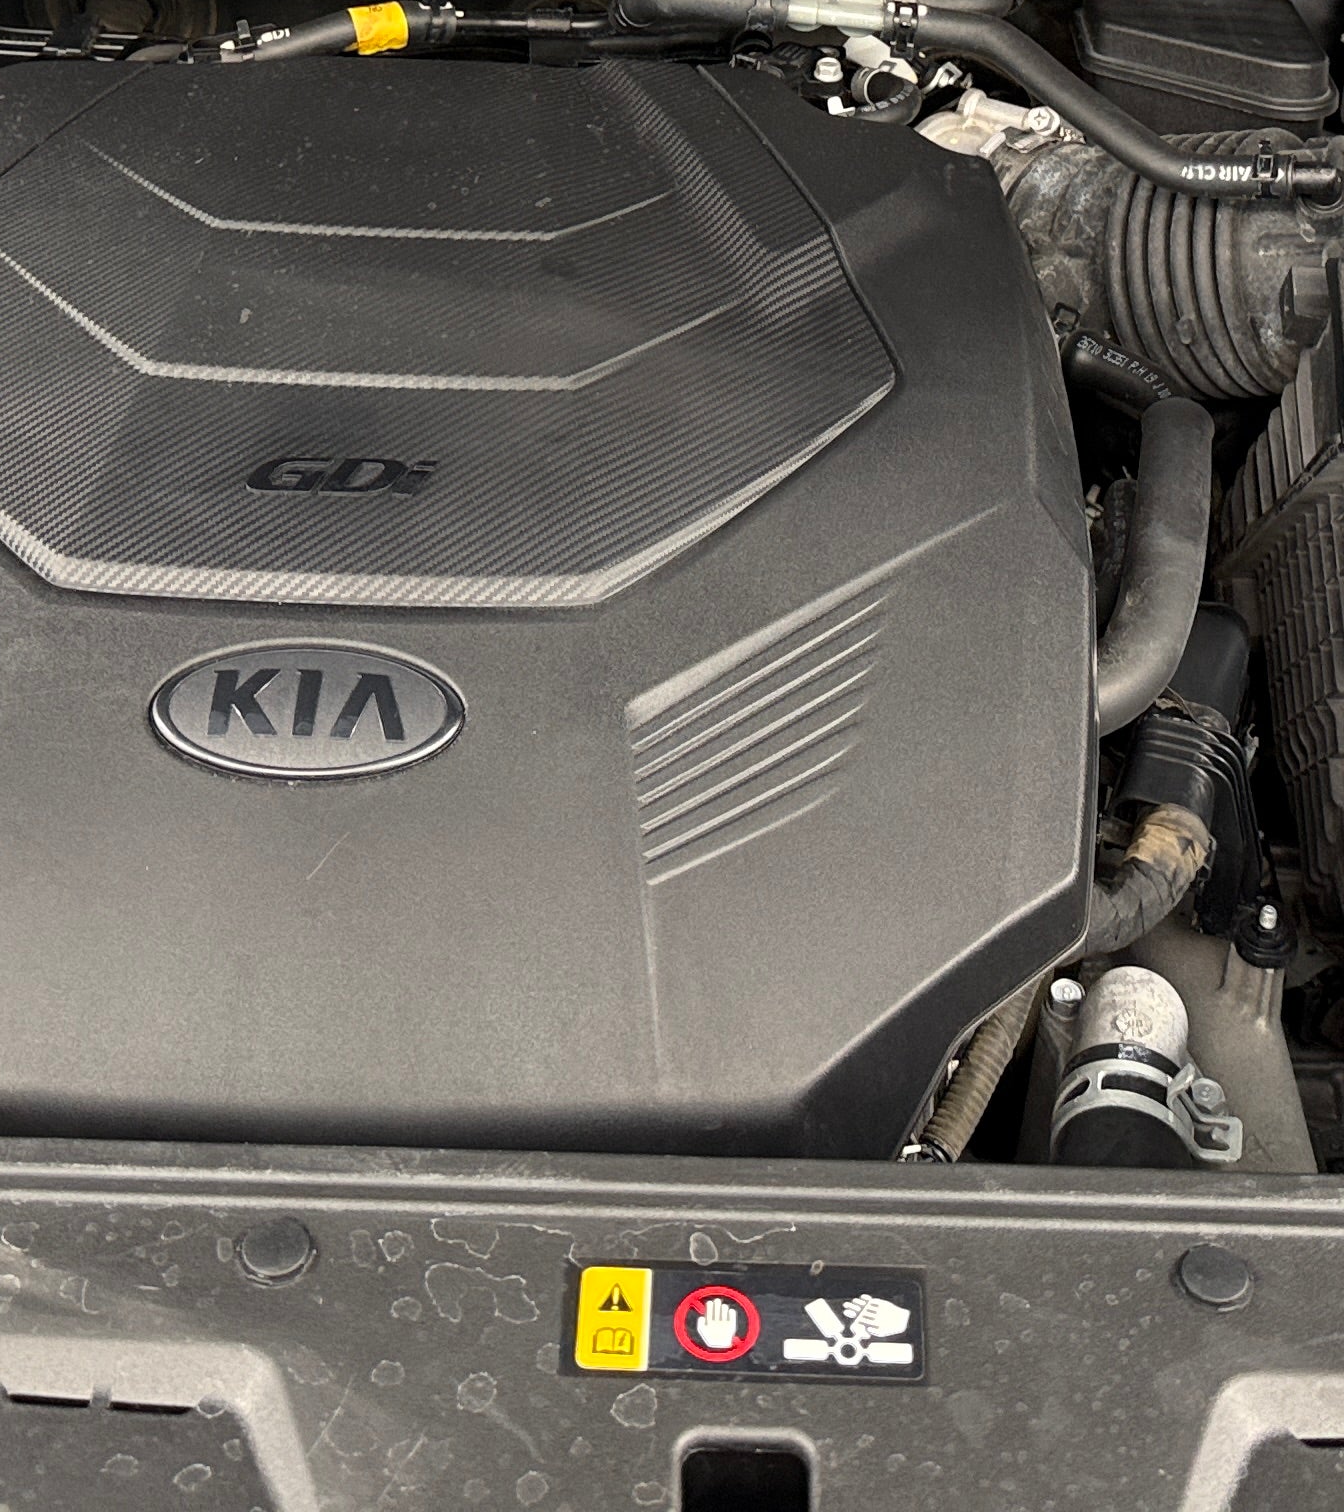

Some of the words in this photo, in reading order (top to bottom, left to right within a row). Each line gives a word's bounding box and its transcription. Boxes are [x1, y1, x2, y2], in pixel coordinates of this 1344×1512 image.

[1219, 165, 1252, 181] AIR
[245, 457, 439, 498] GDi
[207, 667, 407, 744] KIA
